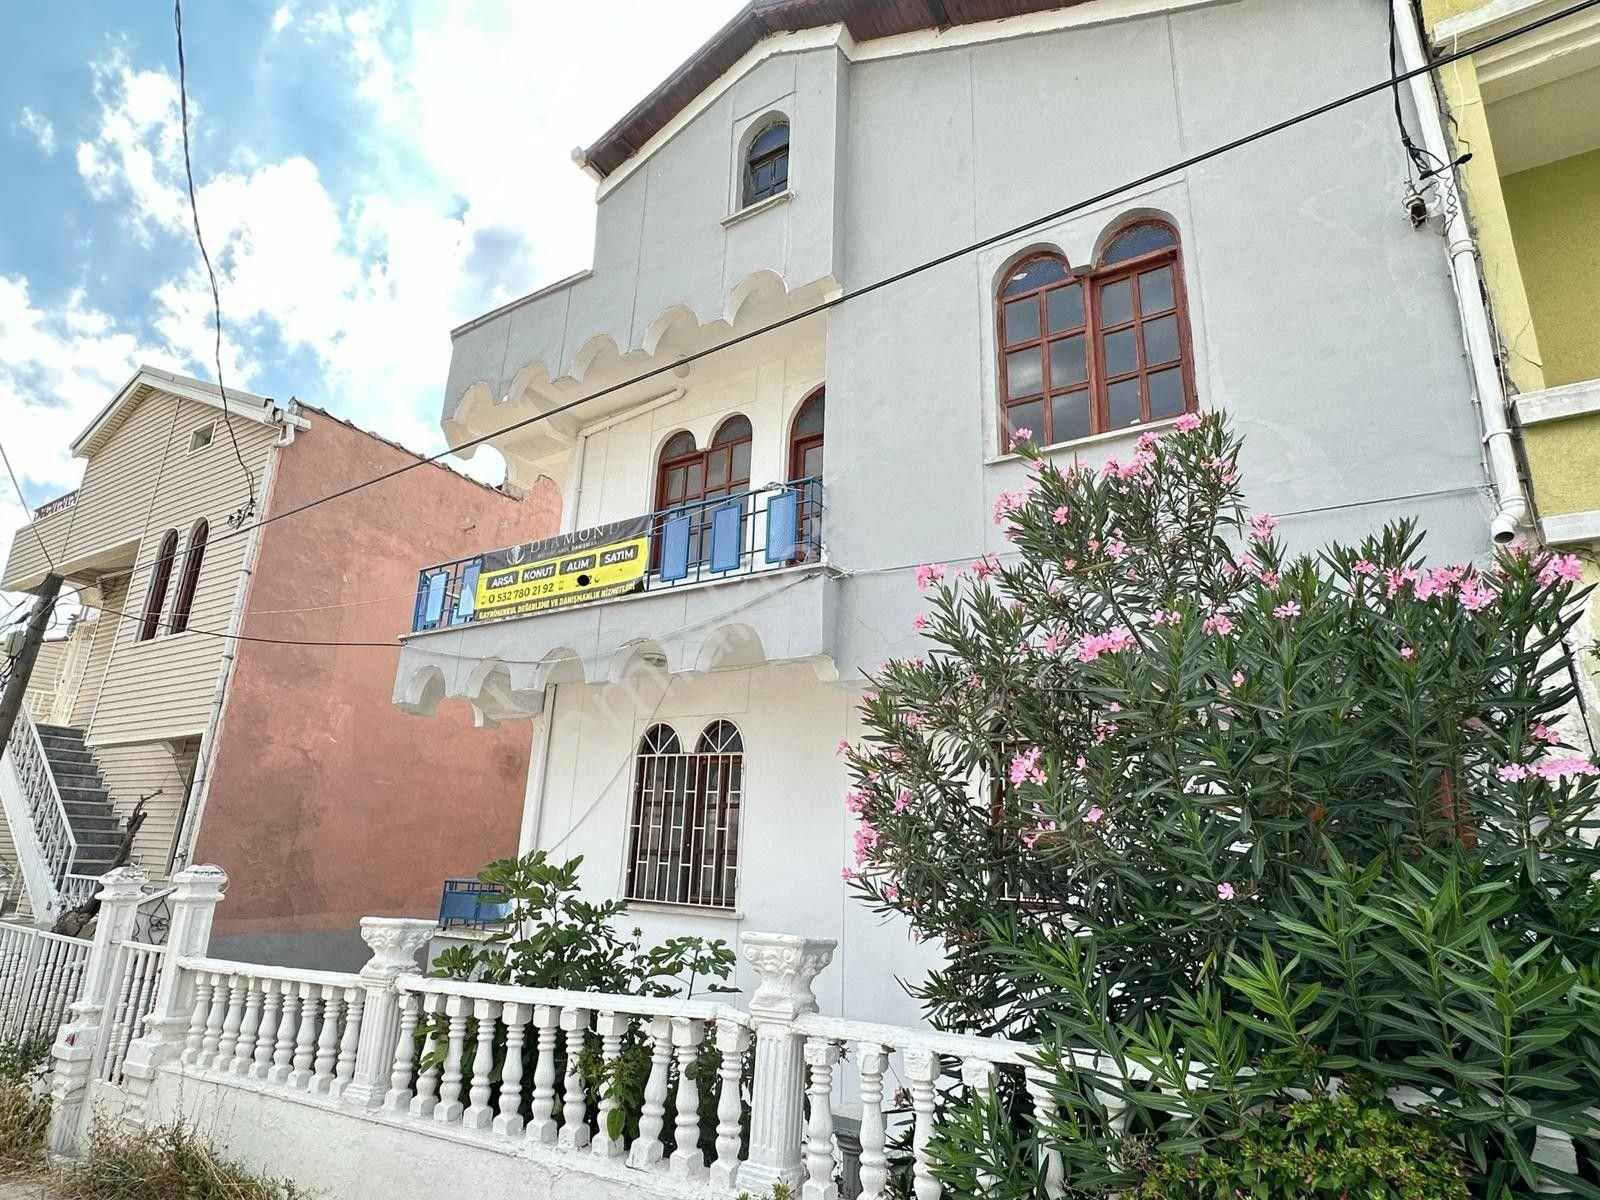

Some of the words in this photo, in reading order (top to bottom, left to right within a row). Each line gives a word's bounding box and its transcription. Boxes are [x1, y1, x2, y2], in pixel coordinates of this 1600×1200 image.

[530, 522, 620, 552] DIAMOND
[491, 576, 514, 588] ARSA
[524, 566, 554, 580] KONUT
[566, 558, 590, 572] ALIM
[604, 548, 634, 564] SATIM
[488, 594, 496, 604] 0
[497, 592, 512, 602] 532
[514, 588, 530, 599] 780
[532, 585, 540, 596] 21
[542, 582, 554, 594] 92
[550, 599, 558, 607] VE
